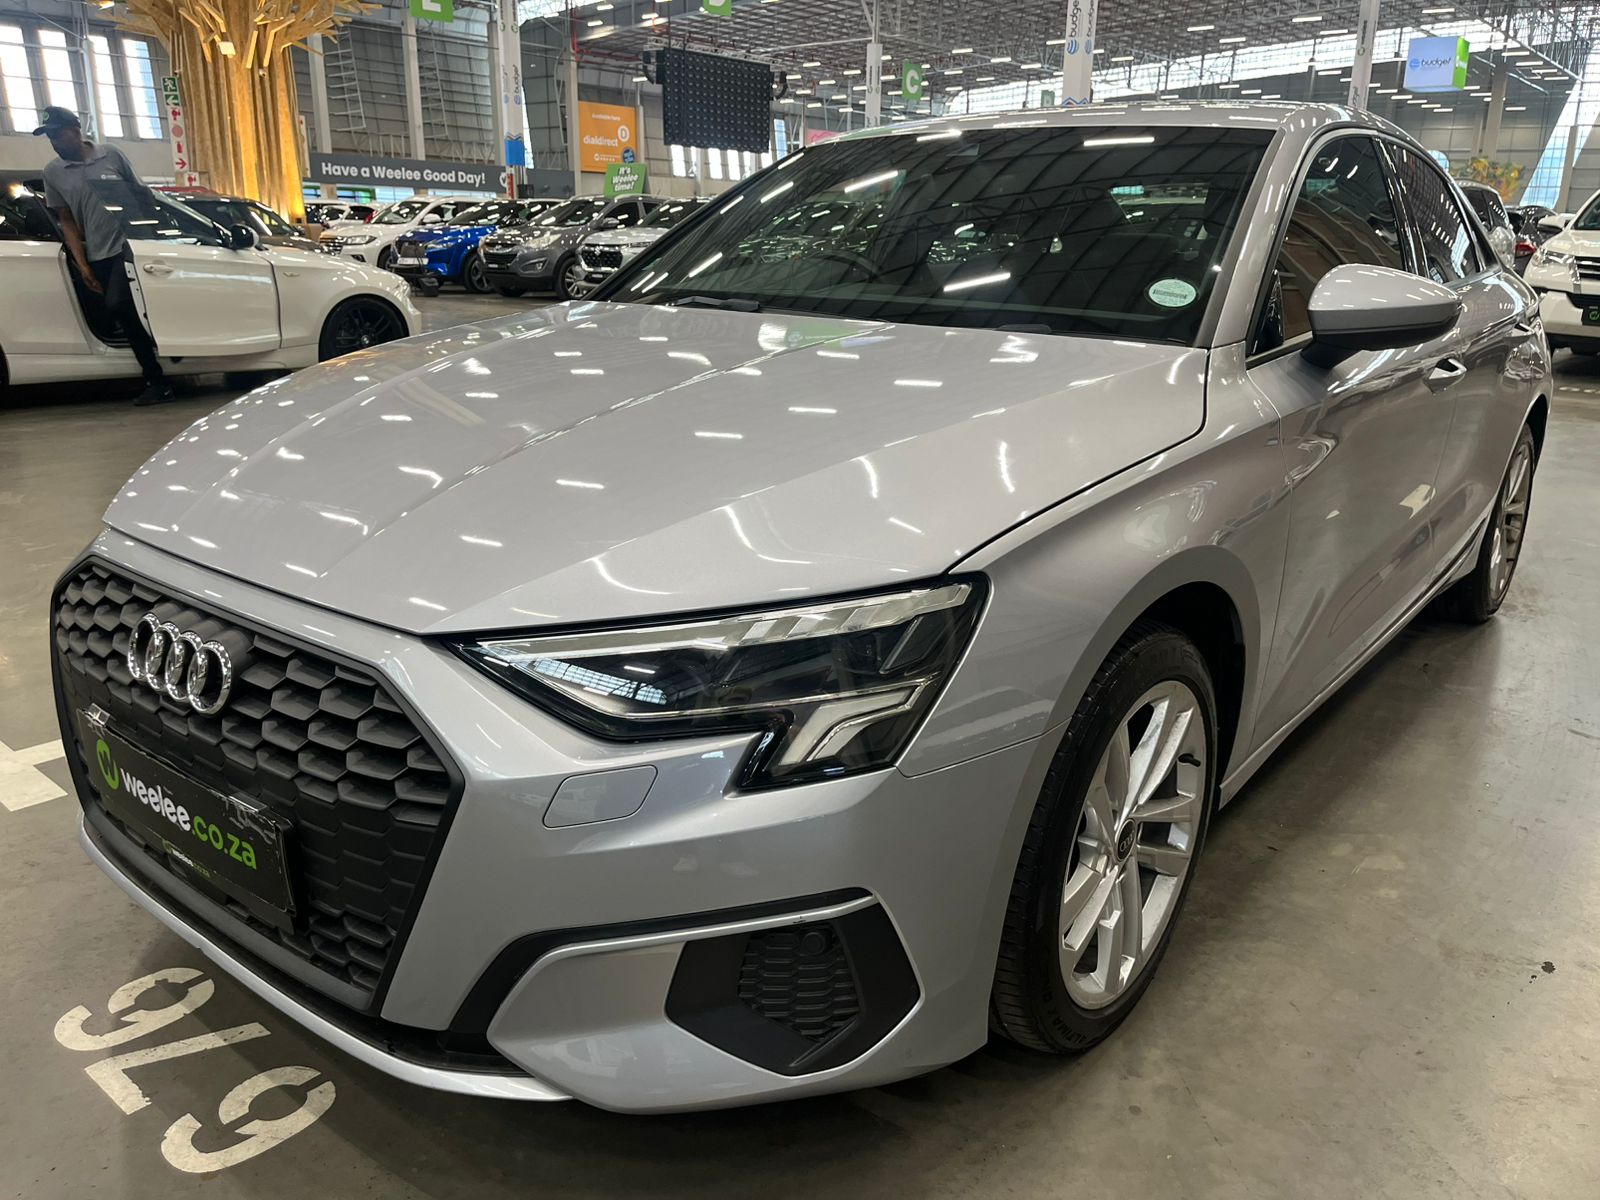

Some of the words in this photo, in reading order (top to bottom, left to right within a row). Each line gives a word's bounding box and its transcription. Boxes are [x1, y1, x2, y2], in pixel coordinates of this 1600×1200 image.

[1068, 0, 1081, 38] budge
[1421, 57, 1451, 68] budget
[906, 69, 919, 94] C
[321, 162, 358, 177] Have
[361, 167, 370, 178] a
[372, 166, 421, 181] Weelee
[423, 169, 454, 183] Good
[458, 171, 486, 187] Day!
[619, 166, 631, 175] It's
[614, 182, 634, 192] time!
[120, 768, 257, 870] weelee.co.za
